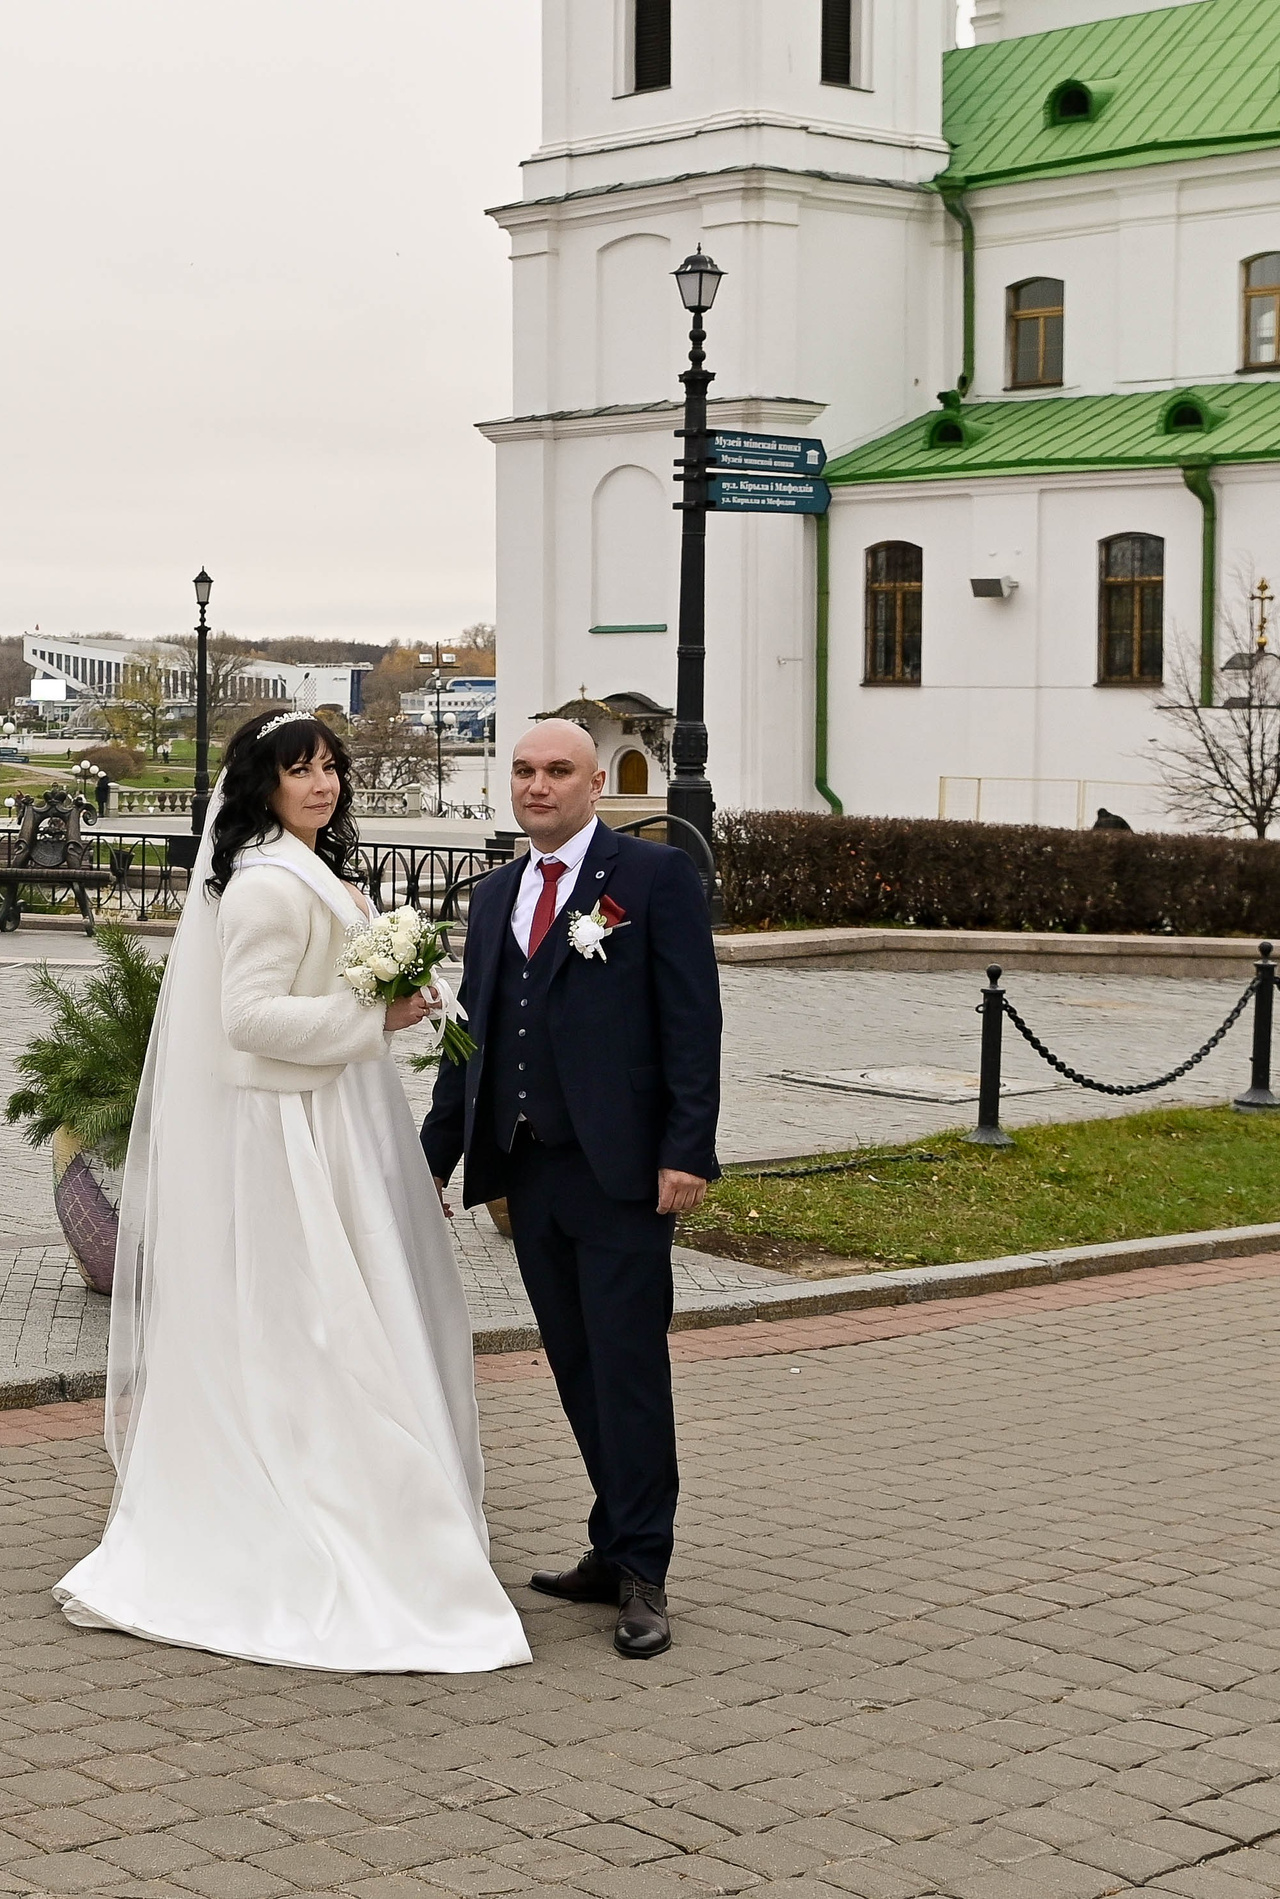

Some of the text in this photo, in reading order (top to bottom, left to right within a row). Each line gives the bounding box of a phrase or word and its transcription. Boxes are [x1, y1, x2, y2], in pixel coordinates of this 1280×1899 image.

[714, 436, 742, 448] Музей
[721, 454, 743, 465] Музей
[722, 482, 738, 491] вул.
